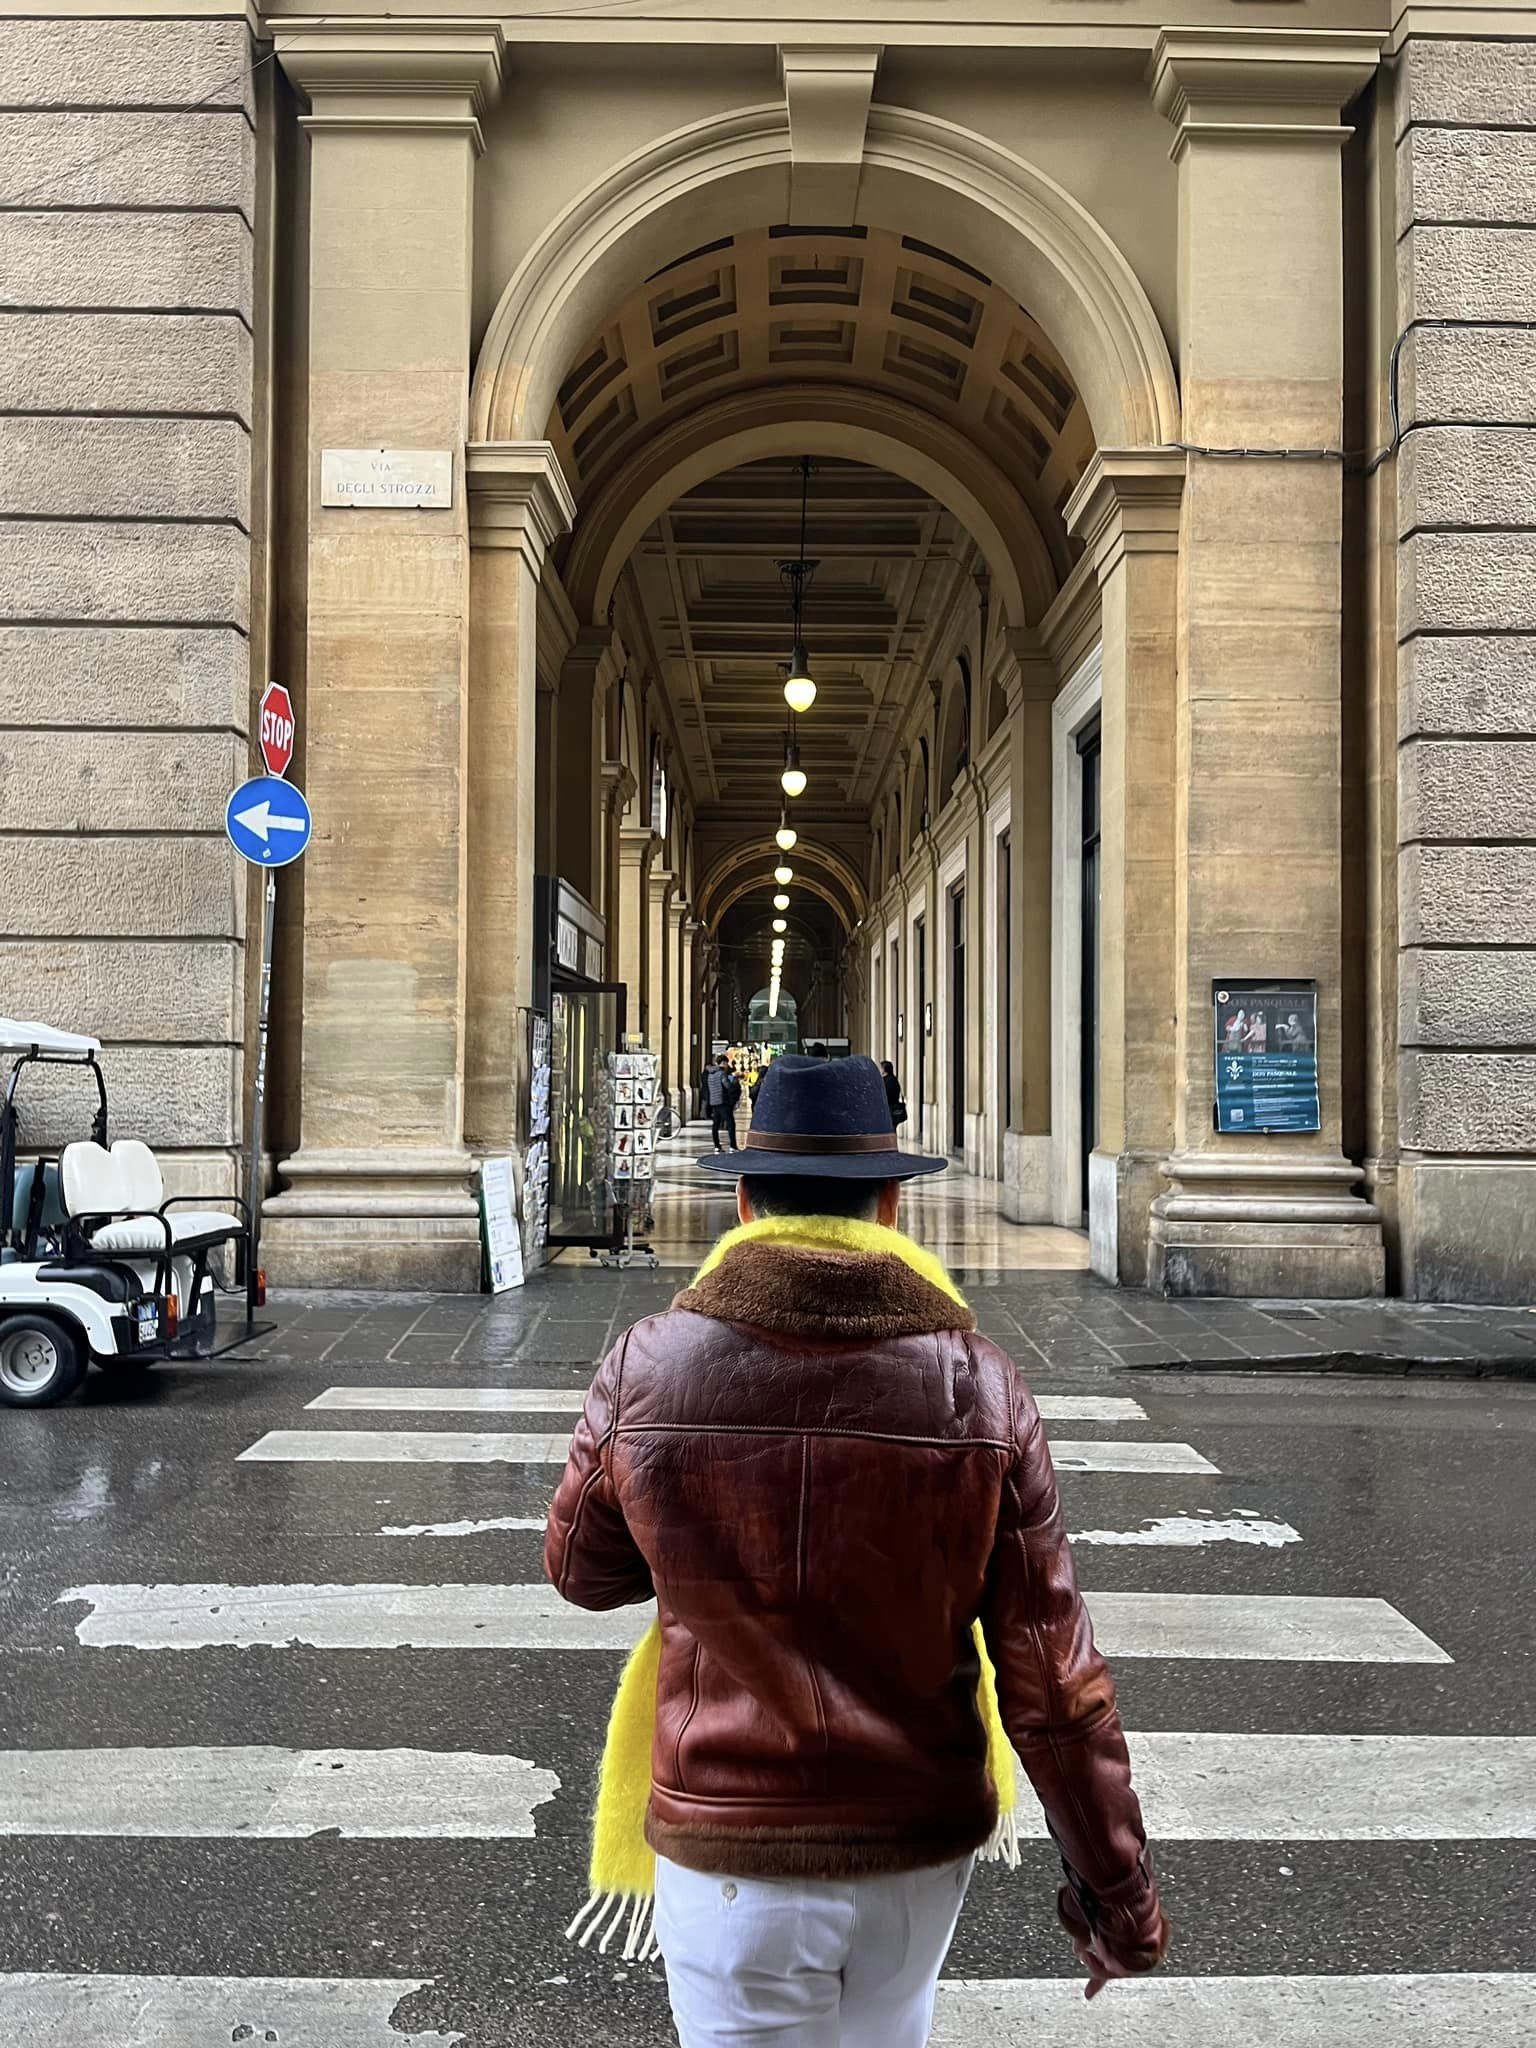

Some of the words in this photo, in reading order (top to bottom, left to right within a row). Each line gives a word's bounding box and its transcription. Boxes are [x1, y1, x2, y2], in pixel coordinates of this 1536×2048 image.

[370, 463, 391, 472] VIA
[337, 483, 375, 494] DEGLI
[380, 483, 436, 495] STROZZI
[263, 709, 292, 752] STOP
